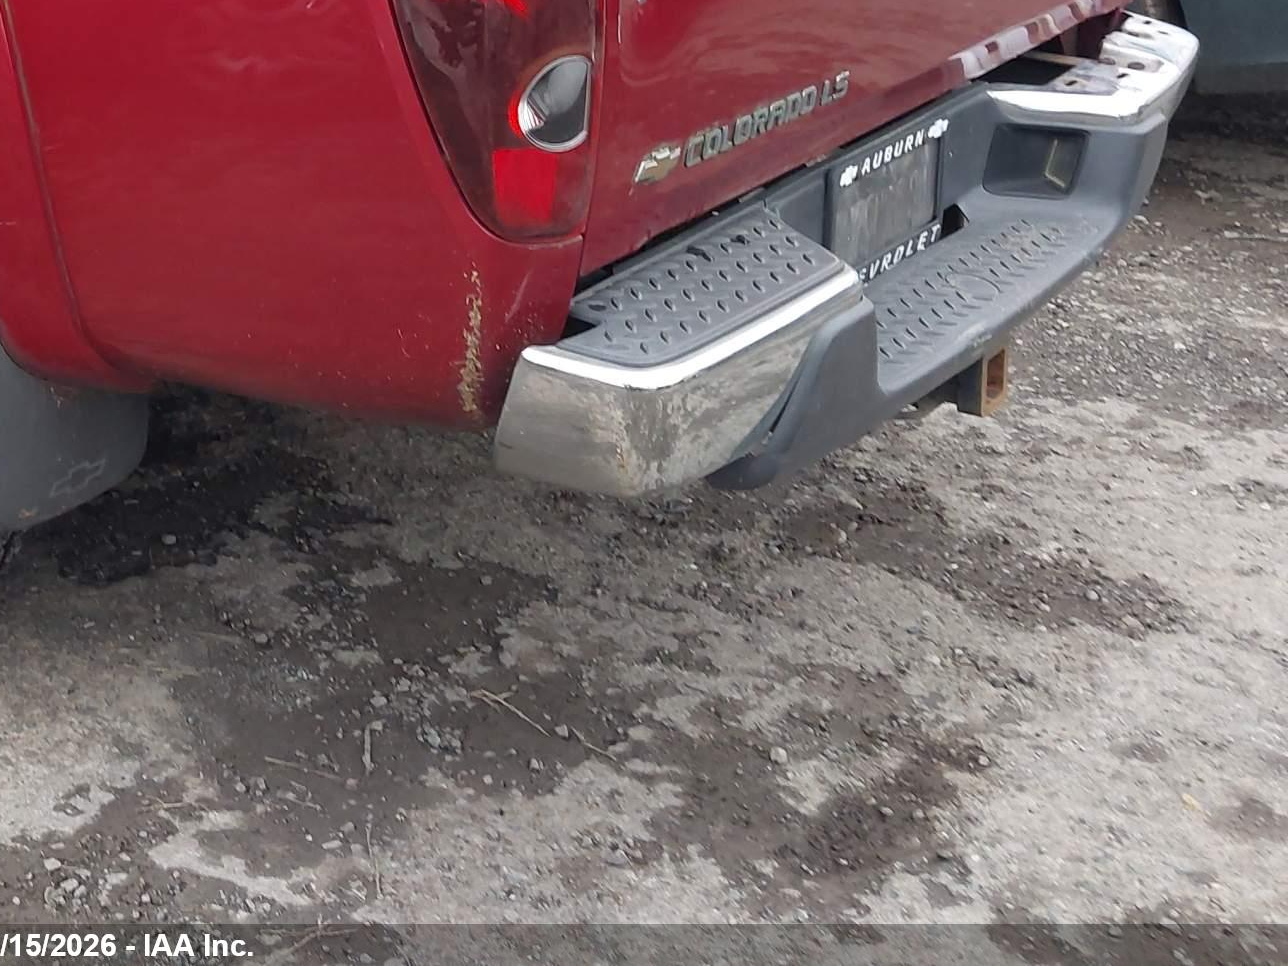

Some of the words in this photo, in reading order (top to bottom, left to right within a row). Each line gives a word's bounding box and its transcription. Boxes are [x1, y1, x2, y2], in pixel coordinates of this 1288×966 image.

[684, 84, 817, 168] COLORADO
[820, 70, 850, 106] LS
[861, 129, 925, 176] AUBURN
